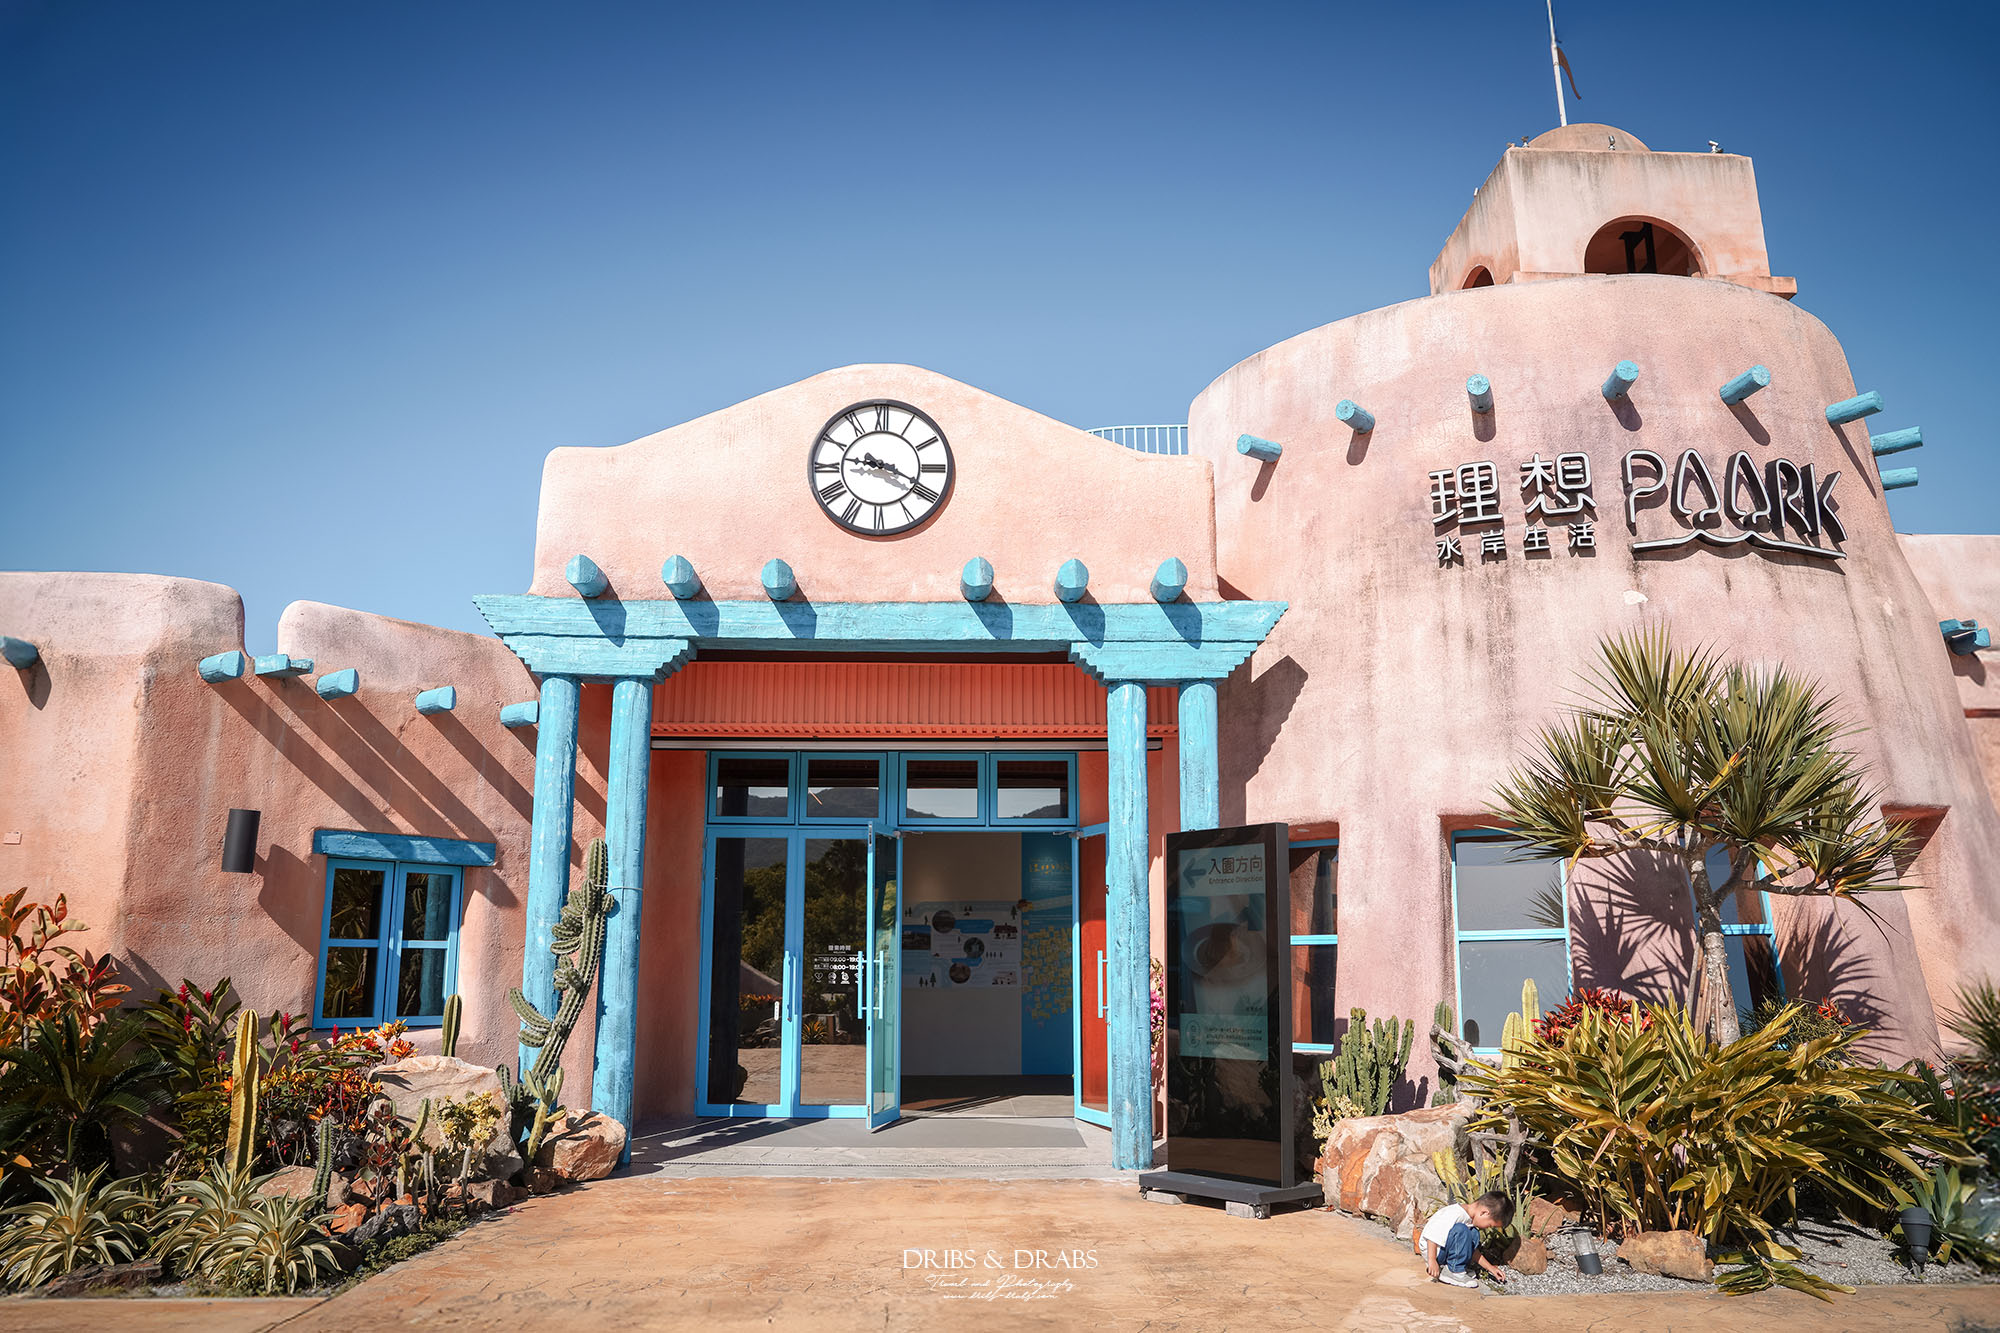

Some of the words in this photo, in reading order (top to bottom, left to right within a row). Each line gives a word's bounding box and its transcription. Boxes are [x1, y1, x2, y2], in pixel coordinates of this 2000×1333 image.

[1429, 452, 1597, 524] 理想
[1436, 521, 1597, 560] 水岸生活
[1208, 855, 1263, 874] 入園方向
